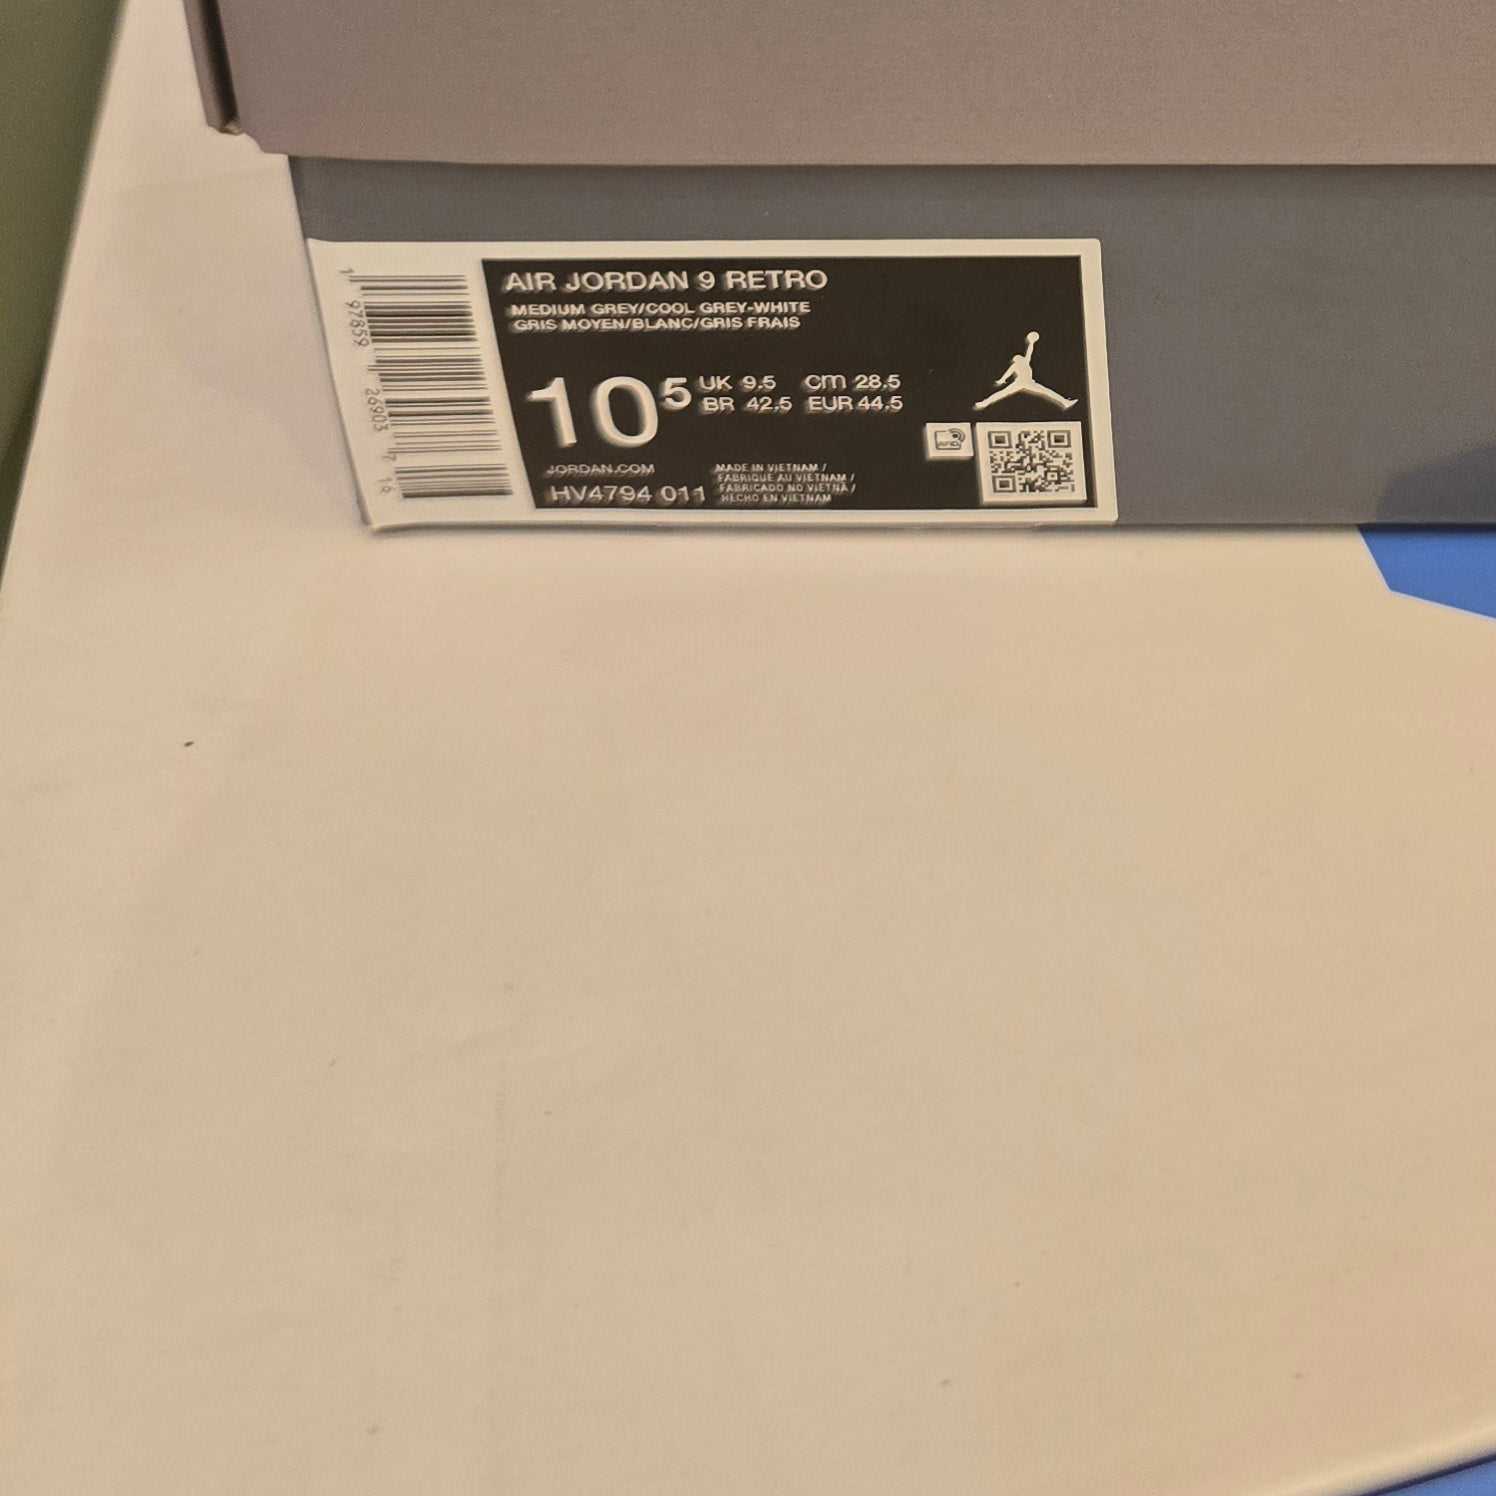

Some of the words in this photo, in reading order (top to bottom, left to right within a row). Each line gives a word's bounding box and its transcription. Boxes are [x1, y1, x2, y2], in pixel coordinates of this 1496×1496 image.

[504, 271, 557, 292] AIR
[563, 271, 689, 292] JORDAN
[697, 270, 716, 291] 9
[724, 269, 828, 291] RETRO
[509, 303, 586, 317] MEDIUM
[589, 303, 695, 316] GREY/COOL
[699, 301, 811, 315] GREY-WHITE
[513, 318, 558, 332] GRIS
[561, 317, 743, 331] MOYEN/BLANC/GRIS
[746, 316, 801, 330] FRAIS
[346, 300, 369, 347] 97859
[364, 388, 389, 433] 26903
[699, 375, 733, 391] UK
[741, 374, 777, 391] 9.5
[854, 374, 901, 390] 28.5
[701, 396, 736, 413] BR
[745, 396, 793, 412] 42.5
[806, 395, 854, 411] EUR
[856, 395, 904, 411] 44.5
[547, 463, 655, 475] JORDAN.COM
[714, 463, 748, 472] MADE
[751, 463, 764, 472] IN
[767, 463, 819, 472] VIETNAM
[718, 473, 774, 483] FABRIQUE
[777, 473, 793, 482] AU
[795, 473, 847, 482] VIETNAM
[550, 485, 652, 502] HV4794
[658, 485, 706, 502] 011
[719, 483, 784, 493] FABRICADO
[787, 483, 803, 493] NO
[721, 493, 760, 503] HECHO
[763, 493, 778, 503] EN
[781, 493, 832, 502] VIETNAM
